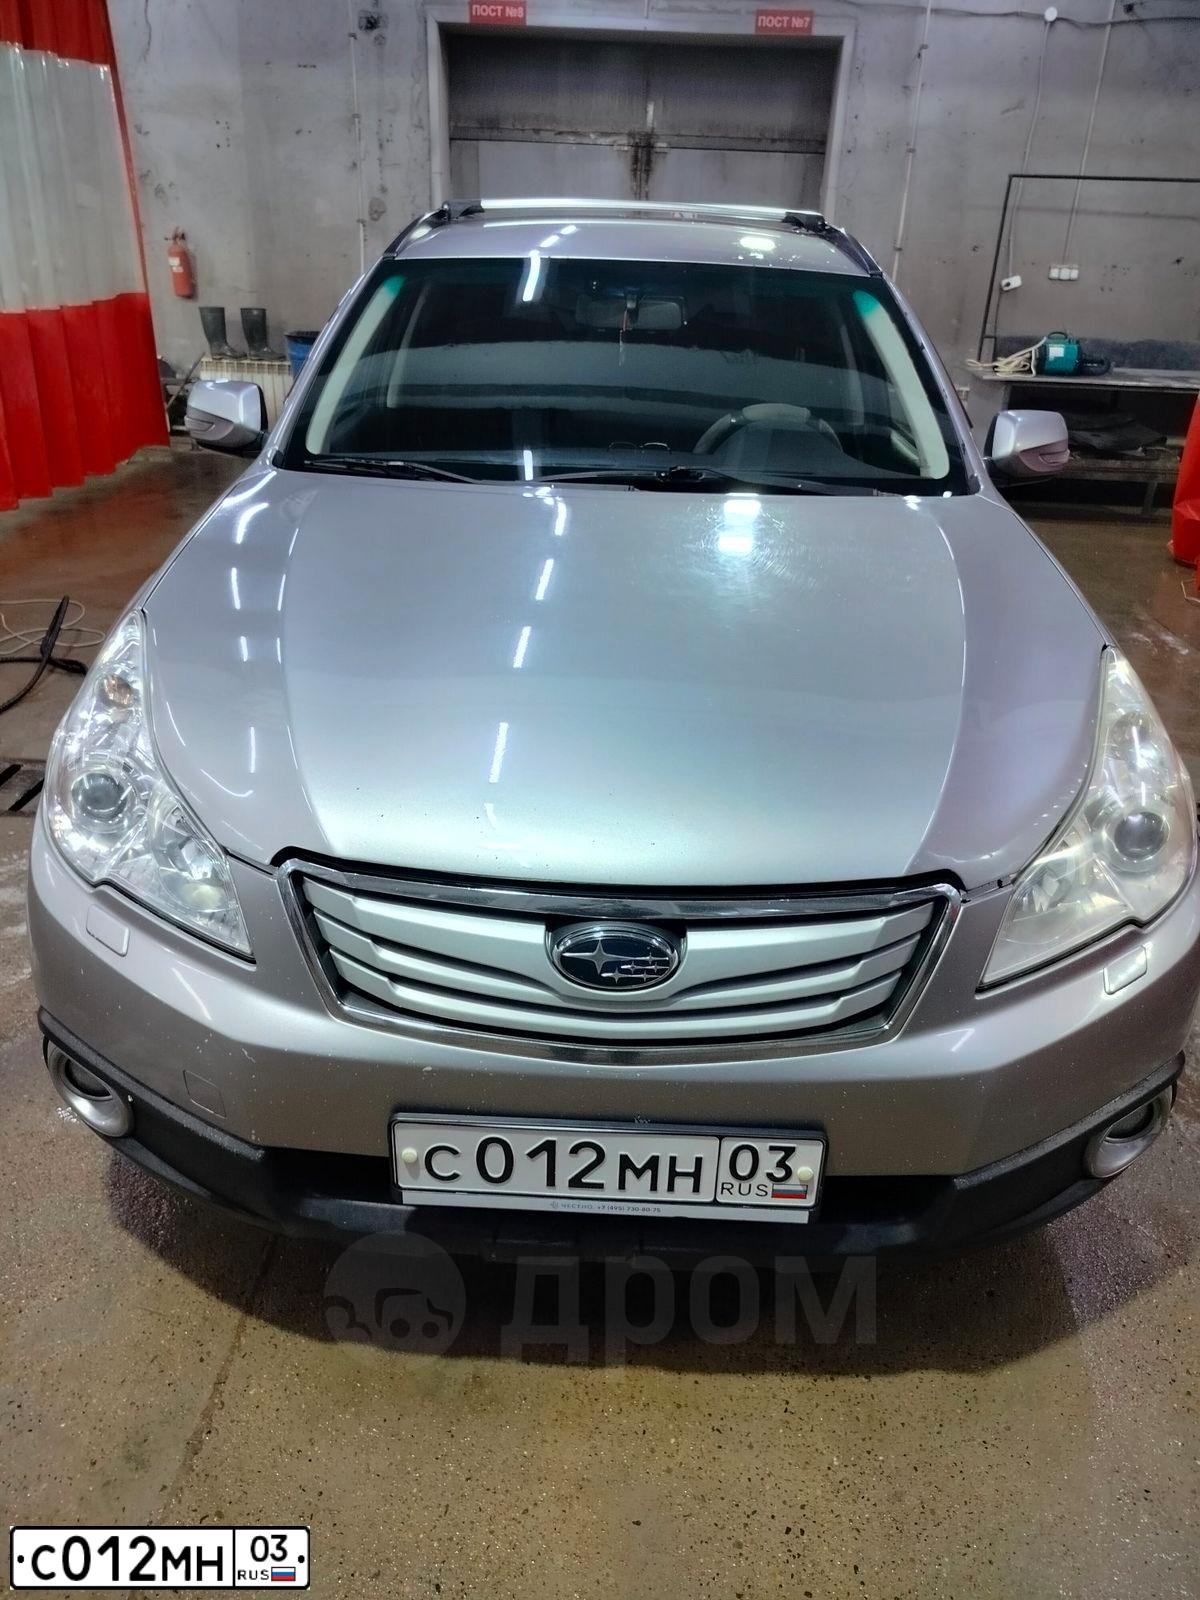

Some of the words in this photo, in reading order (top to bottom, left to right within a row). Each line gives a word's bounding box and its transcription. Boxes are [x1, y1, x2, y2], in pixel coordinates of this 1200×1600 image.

[472, 4, 503, 17] ПОСТ
[758, 15, 789, 28] ПОСТ
[791, 16, 810, 28] №7
[728, 1144, 797, 1183] 03
[720, 1181, 769, 1198] RUS
